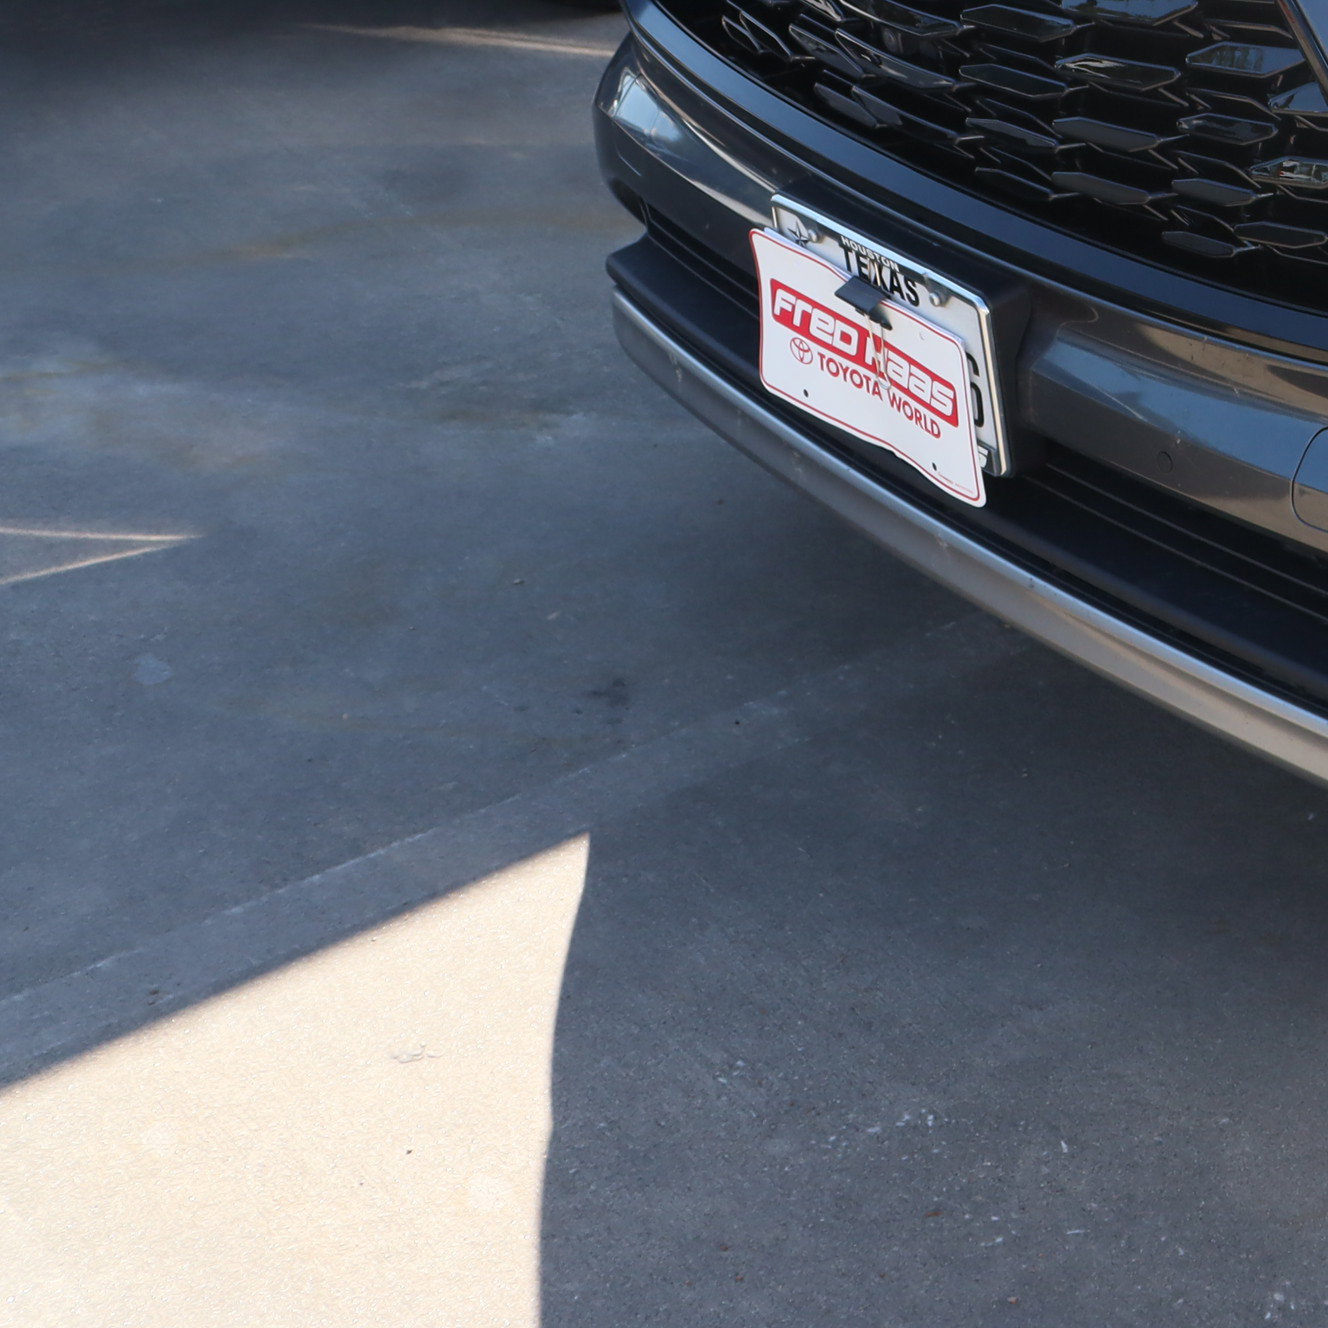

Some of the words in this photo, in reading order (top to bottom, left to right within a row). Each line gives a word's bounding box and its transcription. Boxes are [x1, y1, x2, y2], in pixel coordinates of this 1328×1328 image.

[841, 235, 900, 273] HOUSTON
[841, 243, 920, 307] TEXAS
[817, 351, 883, 402] TOYOTA
[887, 388, 941, 439] WORLD
